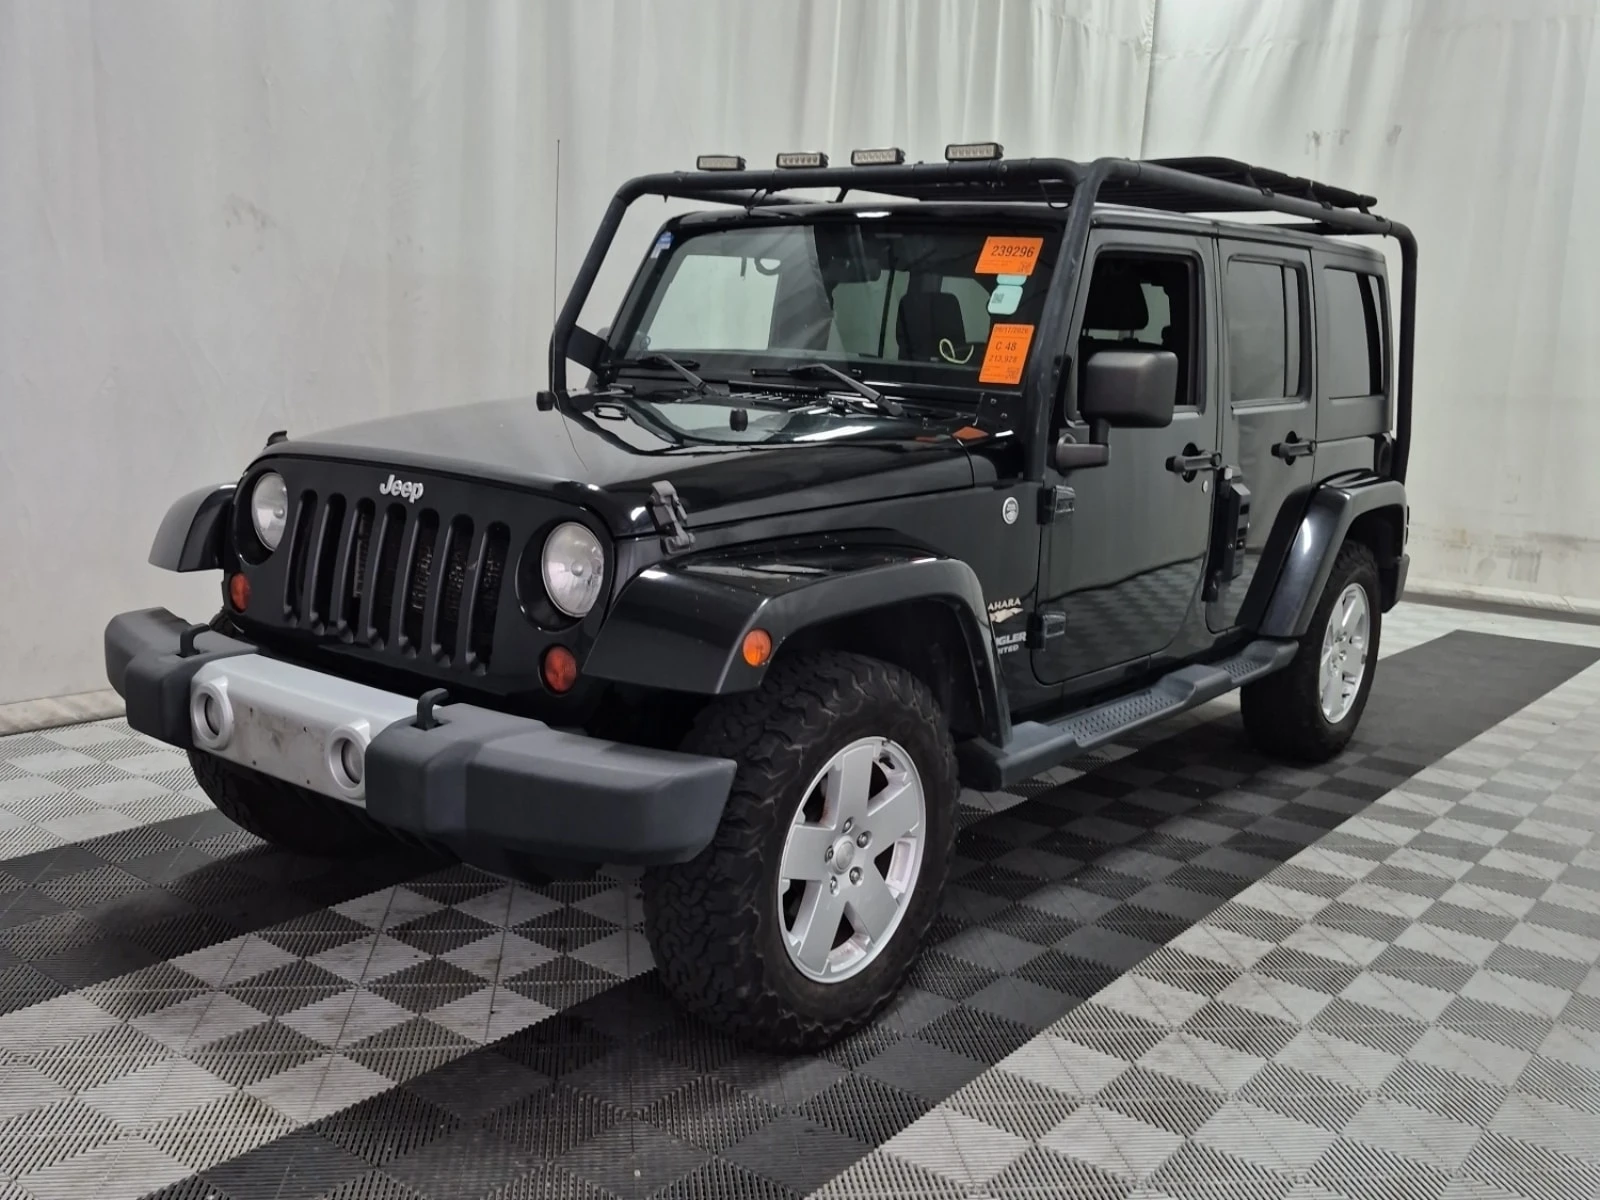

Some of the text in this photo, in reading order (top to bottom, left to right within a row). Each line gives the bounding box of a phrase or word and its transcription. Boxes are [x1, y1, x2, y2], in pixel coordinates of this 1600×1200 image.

[991, 245, 1035, 258] 239296
[1005, 341, 1017, 352] 48
[379, 474, 424, 504] Jeep
[988, 597, 1021, 611] AHARA
[998, 644, 1019, 655] ITED
